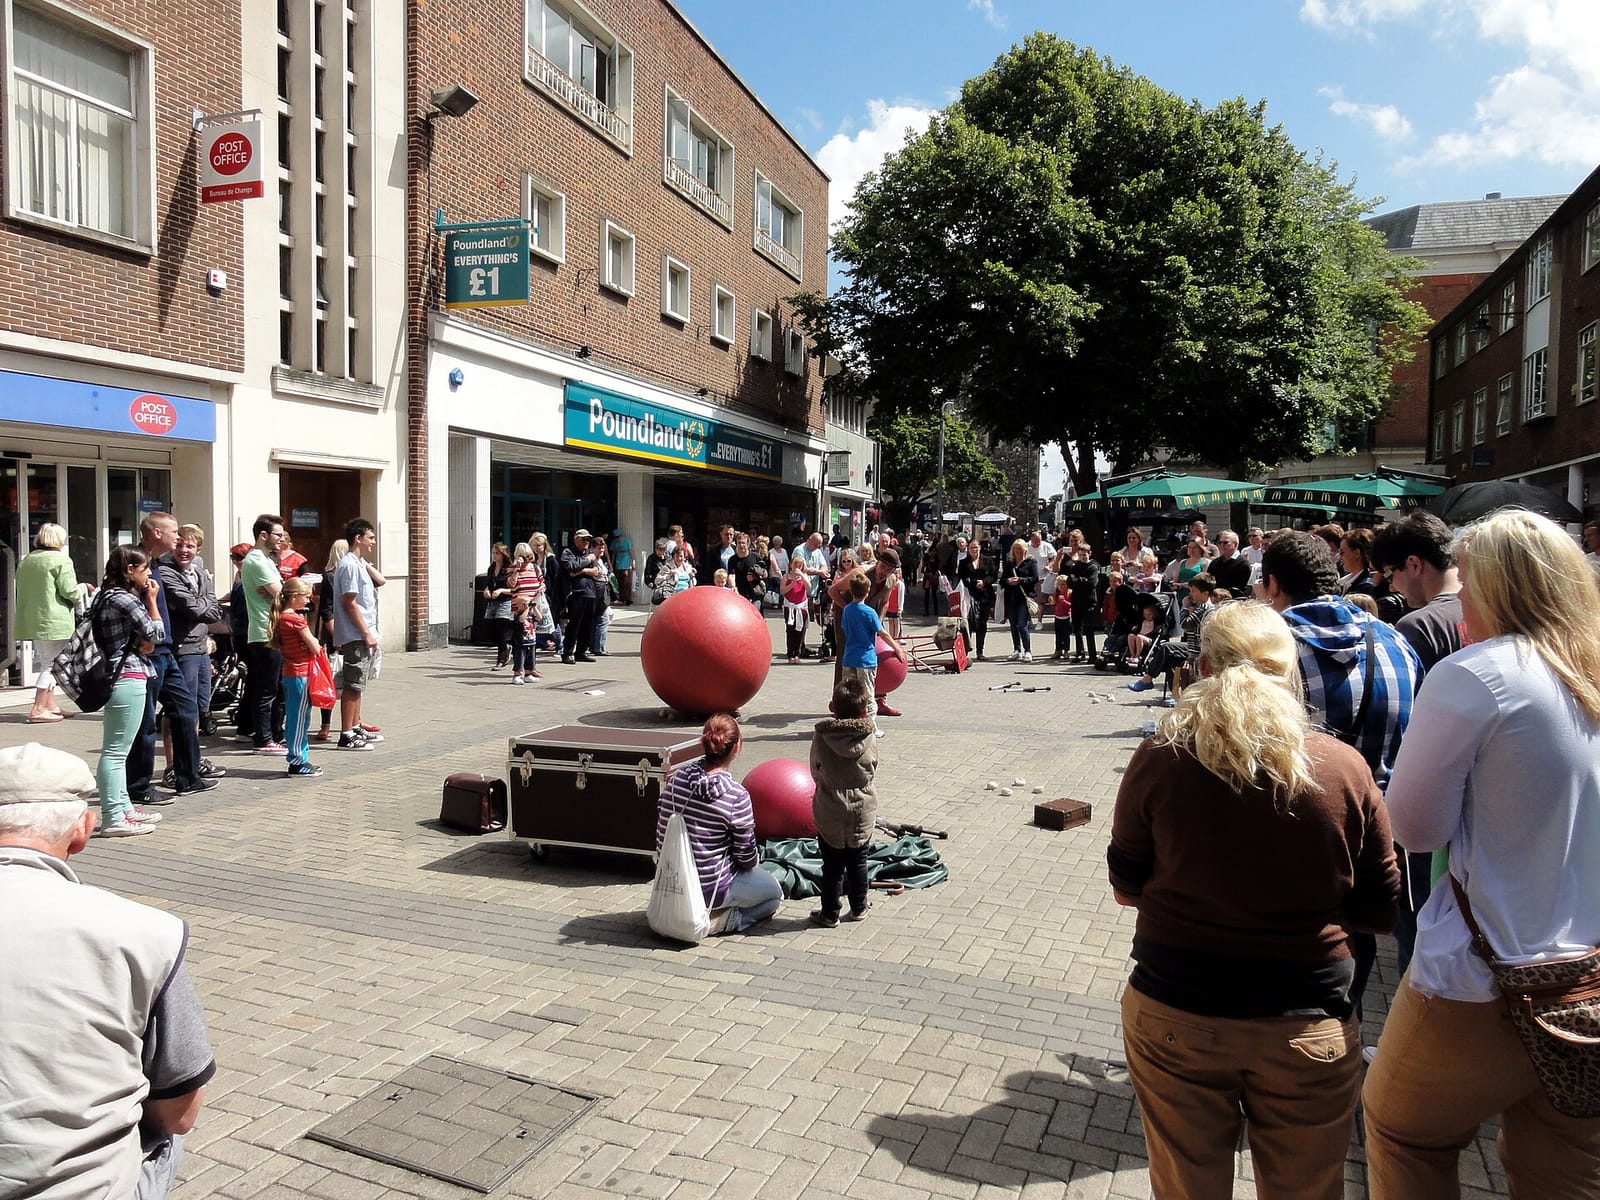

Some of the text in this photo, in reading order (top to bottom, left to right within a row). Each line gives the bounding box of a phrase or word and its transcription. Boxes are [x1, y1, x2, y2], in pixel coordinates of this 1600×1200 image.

[219, 141, 243, 153] POST
[213, 152, 247, 166] OFFICE
[235, 187, 252, 195] Change
[453, 237, 506, 250] Poundland
[454, 253, 518, 266] EVERYTHING'S
[469, 266, 499, 296] £1
[141, 402, 168, 415] POST
[134, 412, 172, 426] OFFICE
[589, 398, 685, 451] Poundland
[761, 444, 772, 469] £1
